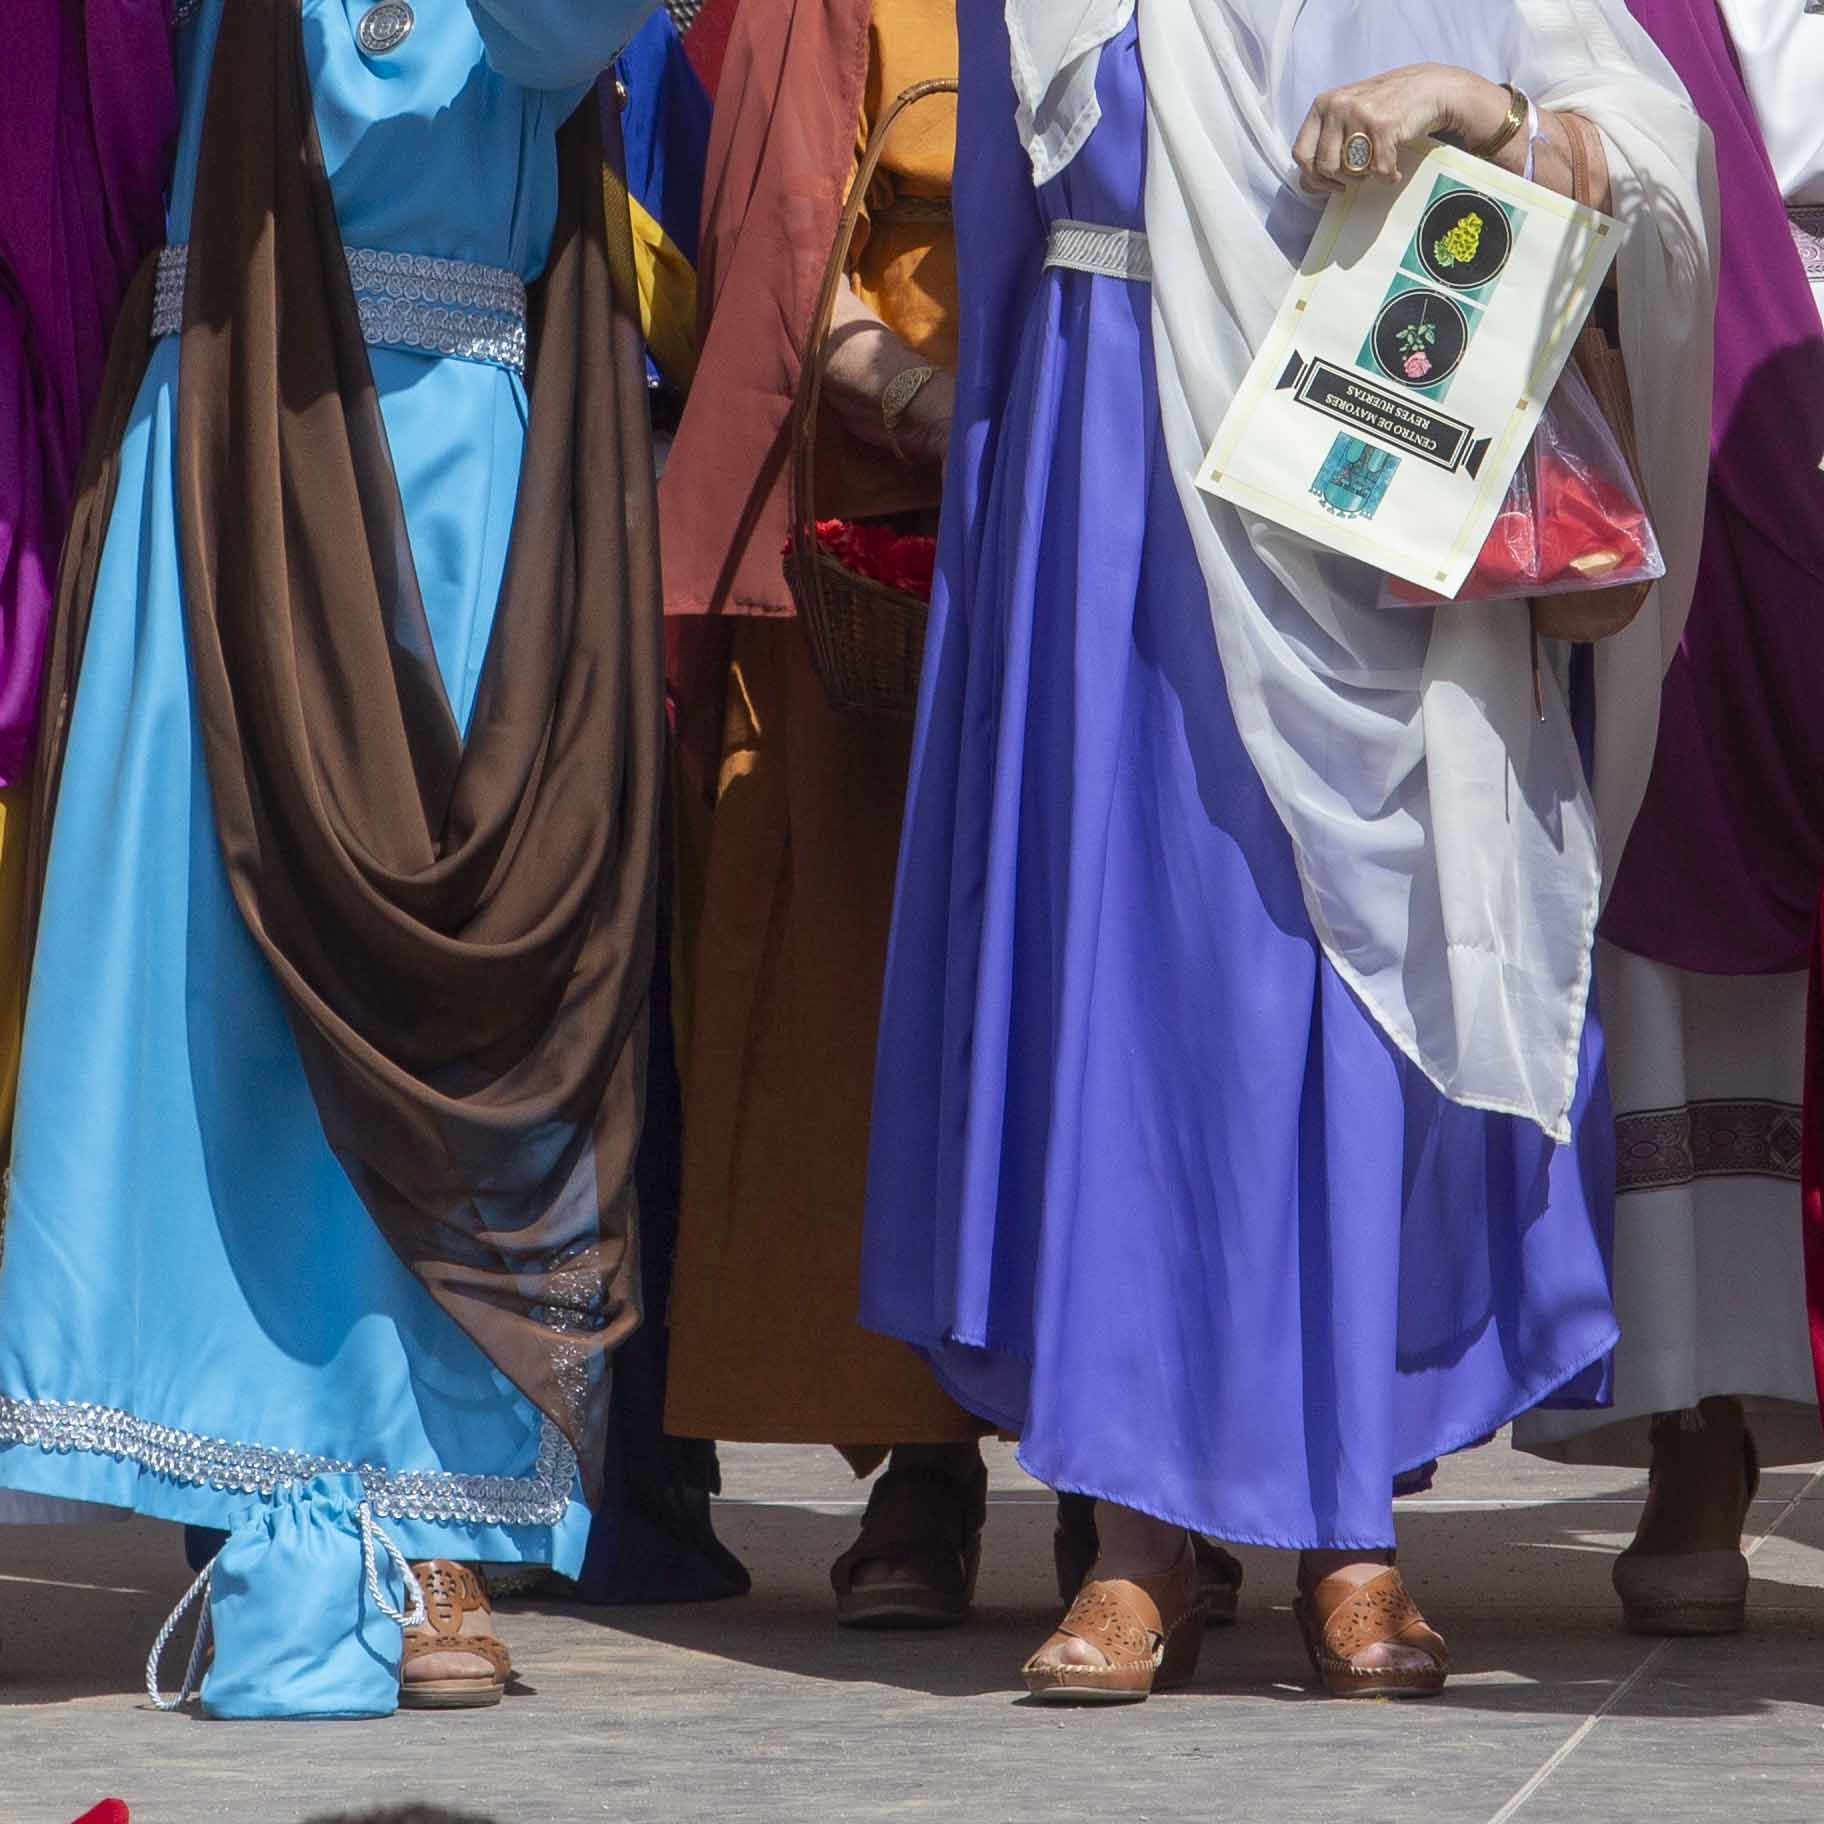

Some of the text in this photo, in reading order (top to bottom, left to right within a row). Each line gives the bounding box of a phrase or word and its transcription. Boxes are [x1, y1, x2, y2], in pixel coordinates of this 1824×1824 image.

[1325, 393, 1437, 451] CENTRO DE MAYORES
[1346, 385, 1431, 430] REYES HUERTAS
